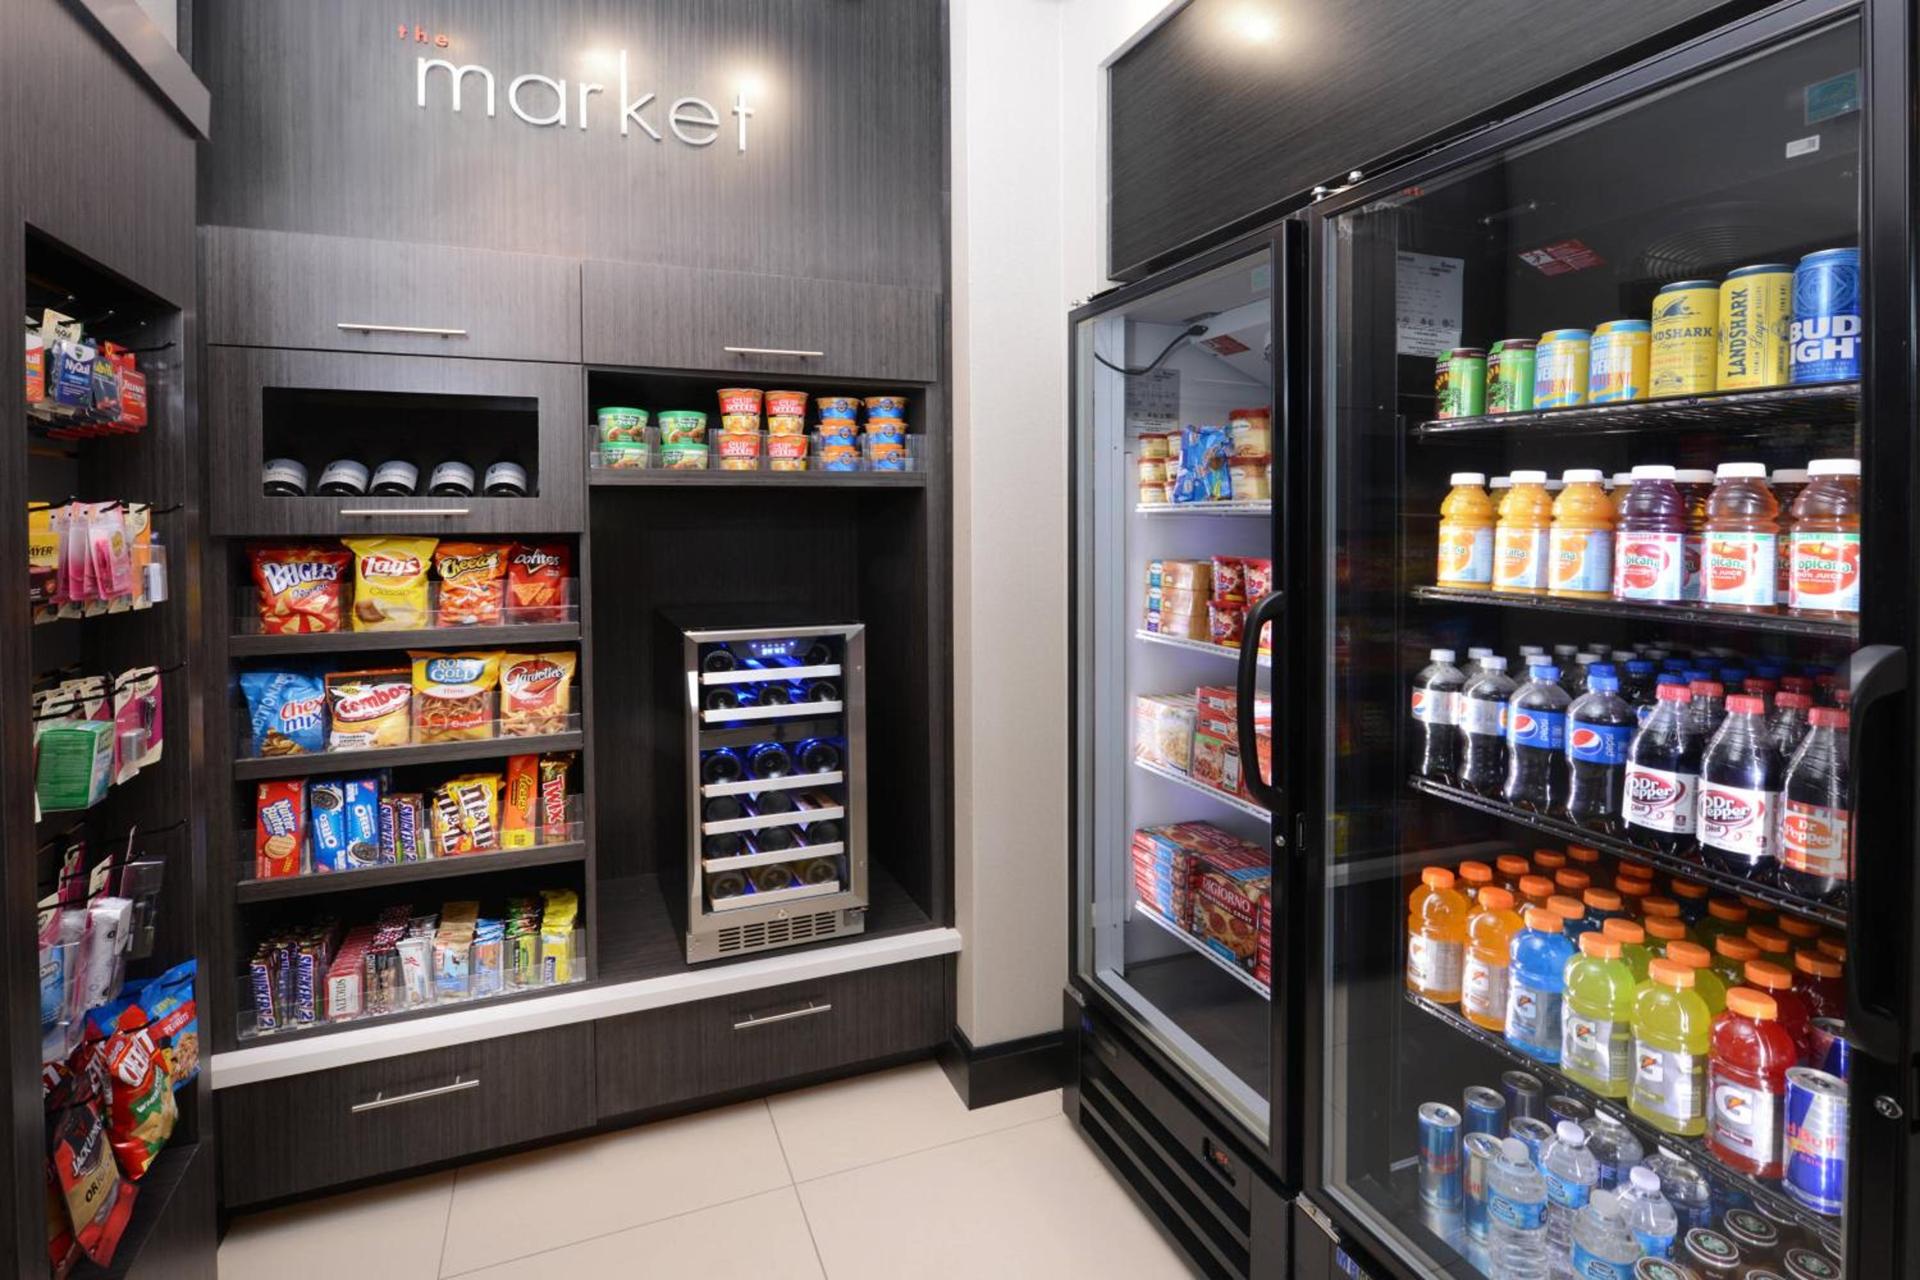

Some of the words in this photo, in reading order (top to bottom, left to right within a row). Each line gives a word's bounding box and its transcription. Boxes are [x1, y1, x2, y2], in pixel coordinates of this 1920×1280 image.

[399, 25, 449, 49] the
[417, 48, 757, 151] market
[1727, 288, 1748, 378] LANDSHARK
[1790, 315, 1861, 344] BUD
[1790, 337, 1861, 366] IGH
[264, 562, 338, 596] BUGLES
[430, 667, 480, 682] GOLD
[280, 696, 326, 722] Chex
[320, 814, 338, 849] OREO
[354, 804, 372, 839] OREO
[400, 802, 417, 852] SNICKERS
[299, 954, 315, 1010] SNICKERS
